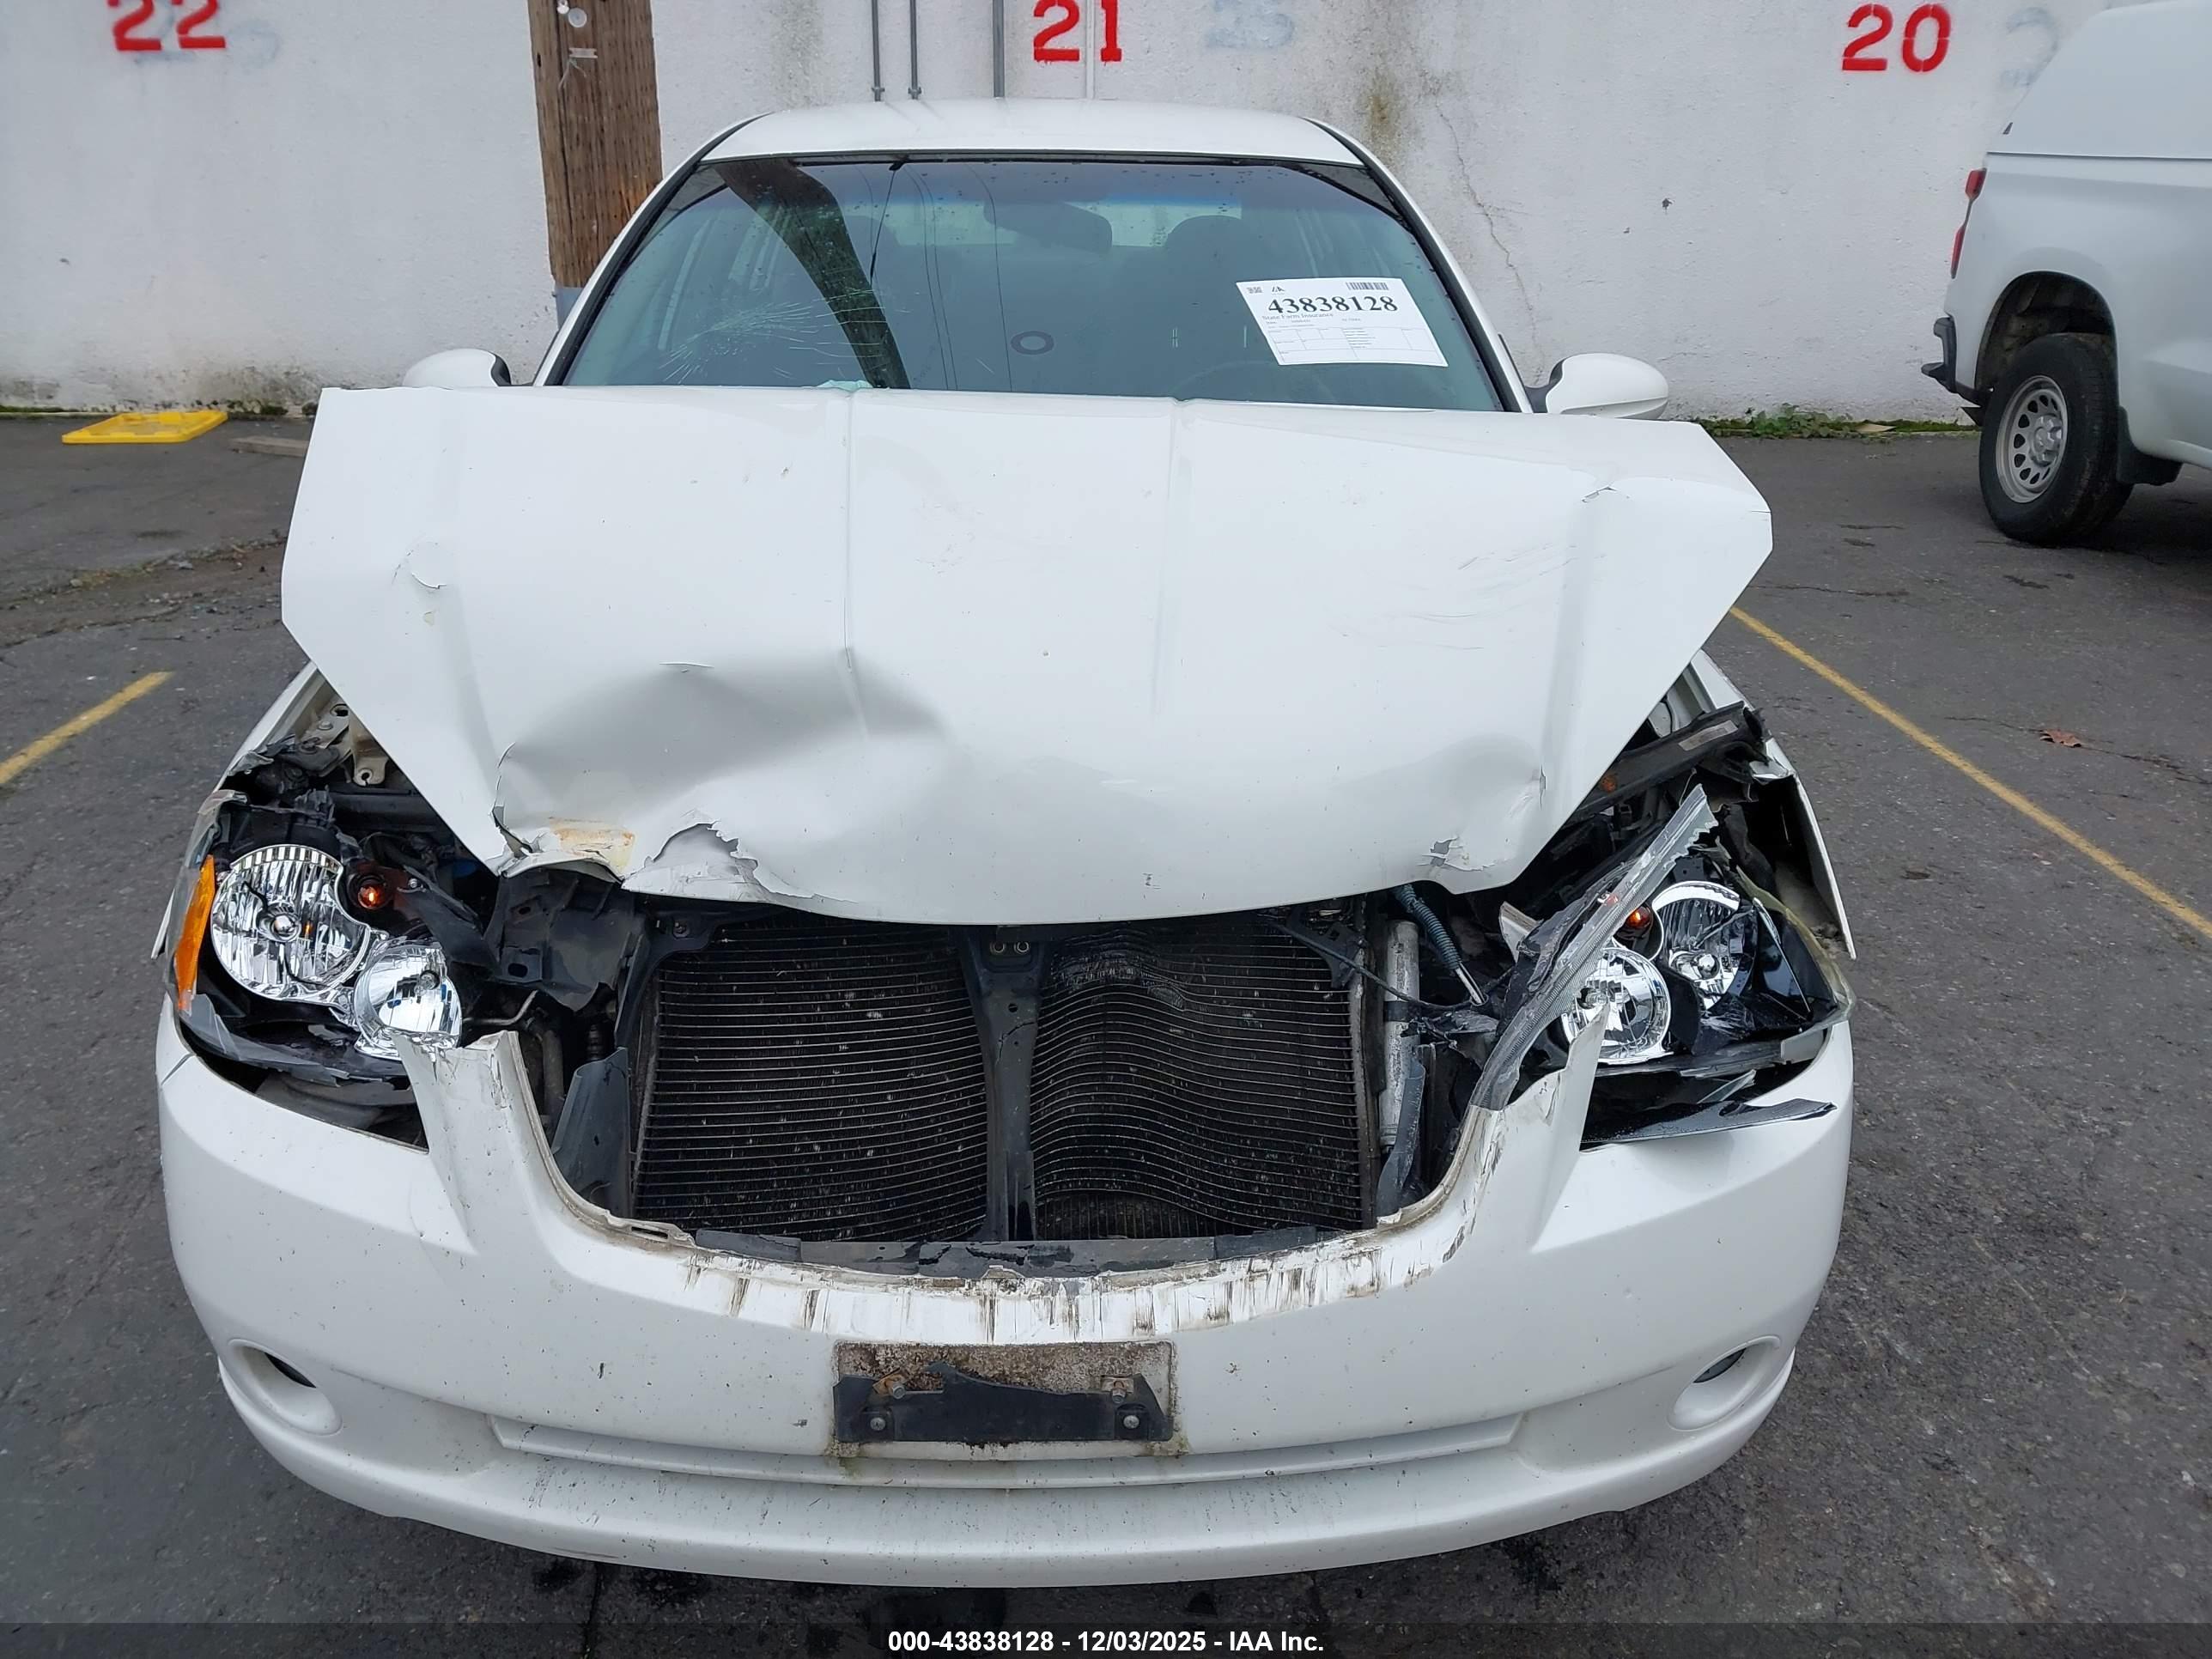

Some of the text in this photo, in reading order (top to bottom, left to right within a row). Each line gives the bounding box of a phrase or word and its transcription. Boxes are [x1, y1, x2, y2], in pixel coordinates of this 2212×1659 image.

[106, 0, 227, 52] 22
[1033, 0, 1122, 63] 21
[1841, 3, 1952, 73] 20
[1268, 295, 1398, 313] 43838128
